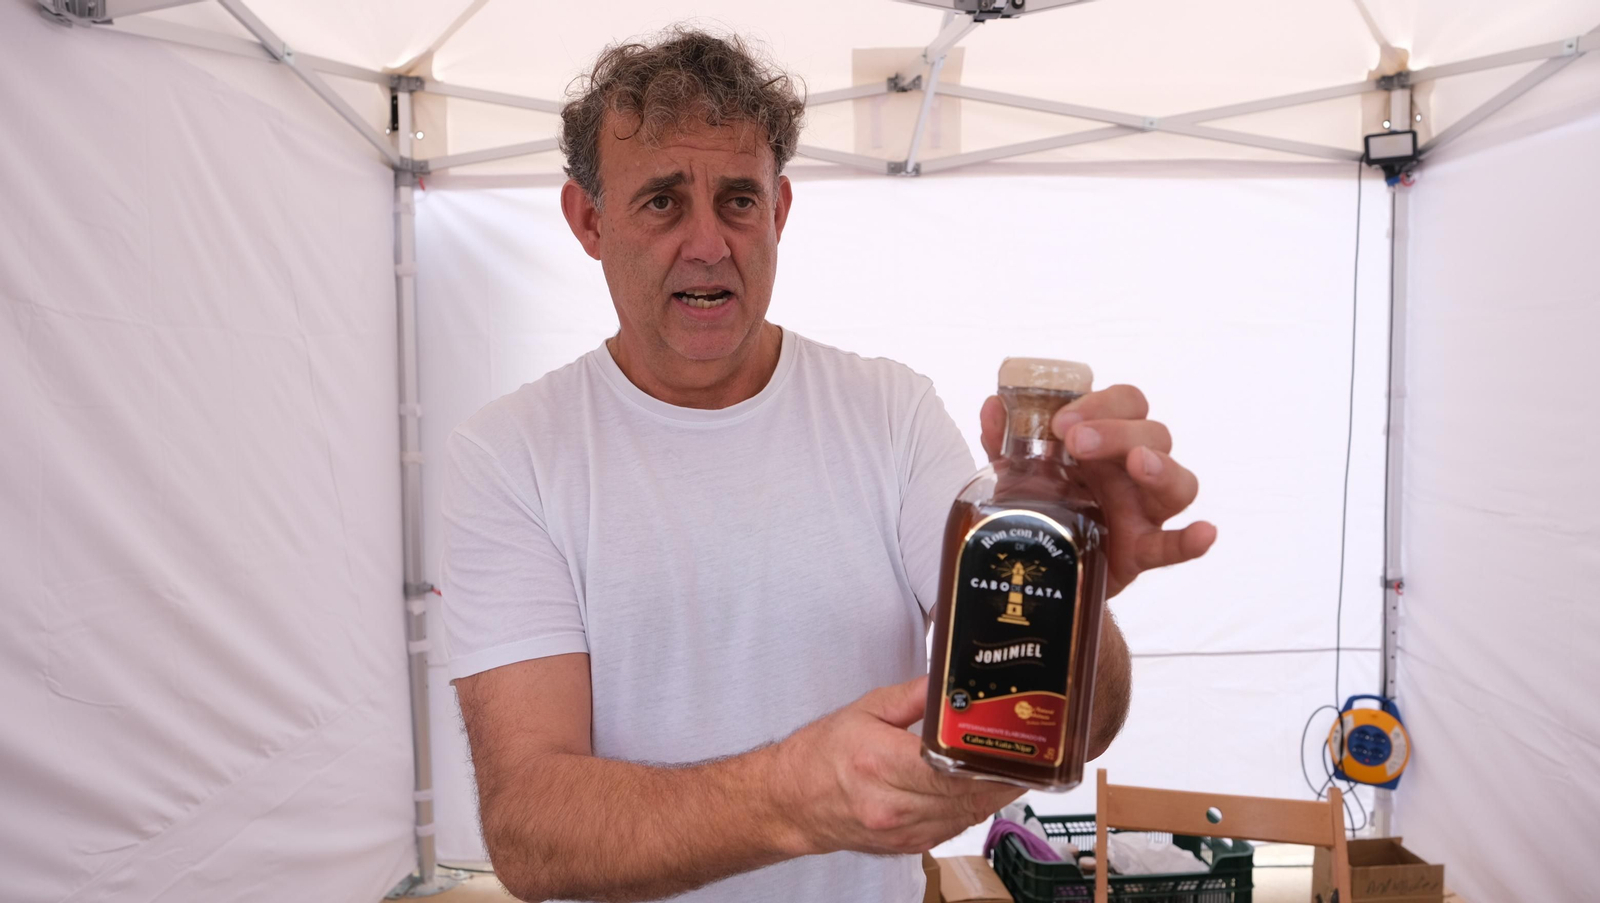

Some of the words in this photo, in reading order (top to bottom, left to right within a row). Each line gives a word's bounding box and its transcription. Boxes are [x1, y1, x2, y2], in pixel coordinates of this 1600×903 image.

[980, 530, 1007, 549] Ron
[1009, 528, 1033, 539] con
[1035, 530, 1063, 557] Miel
[1015, 543, 1025, 551] DE
[970, 577, 1010, 592] CABO
[1024, 585, 1063, 600] GATA
[974, 642, 1042, 664] JONIMIEL
[965, 735, 984, 745] Cabo
[985, 738, 994, 746] de
